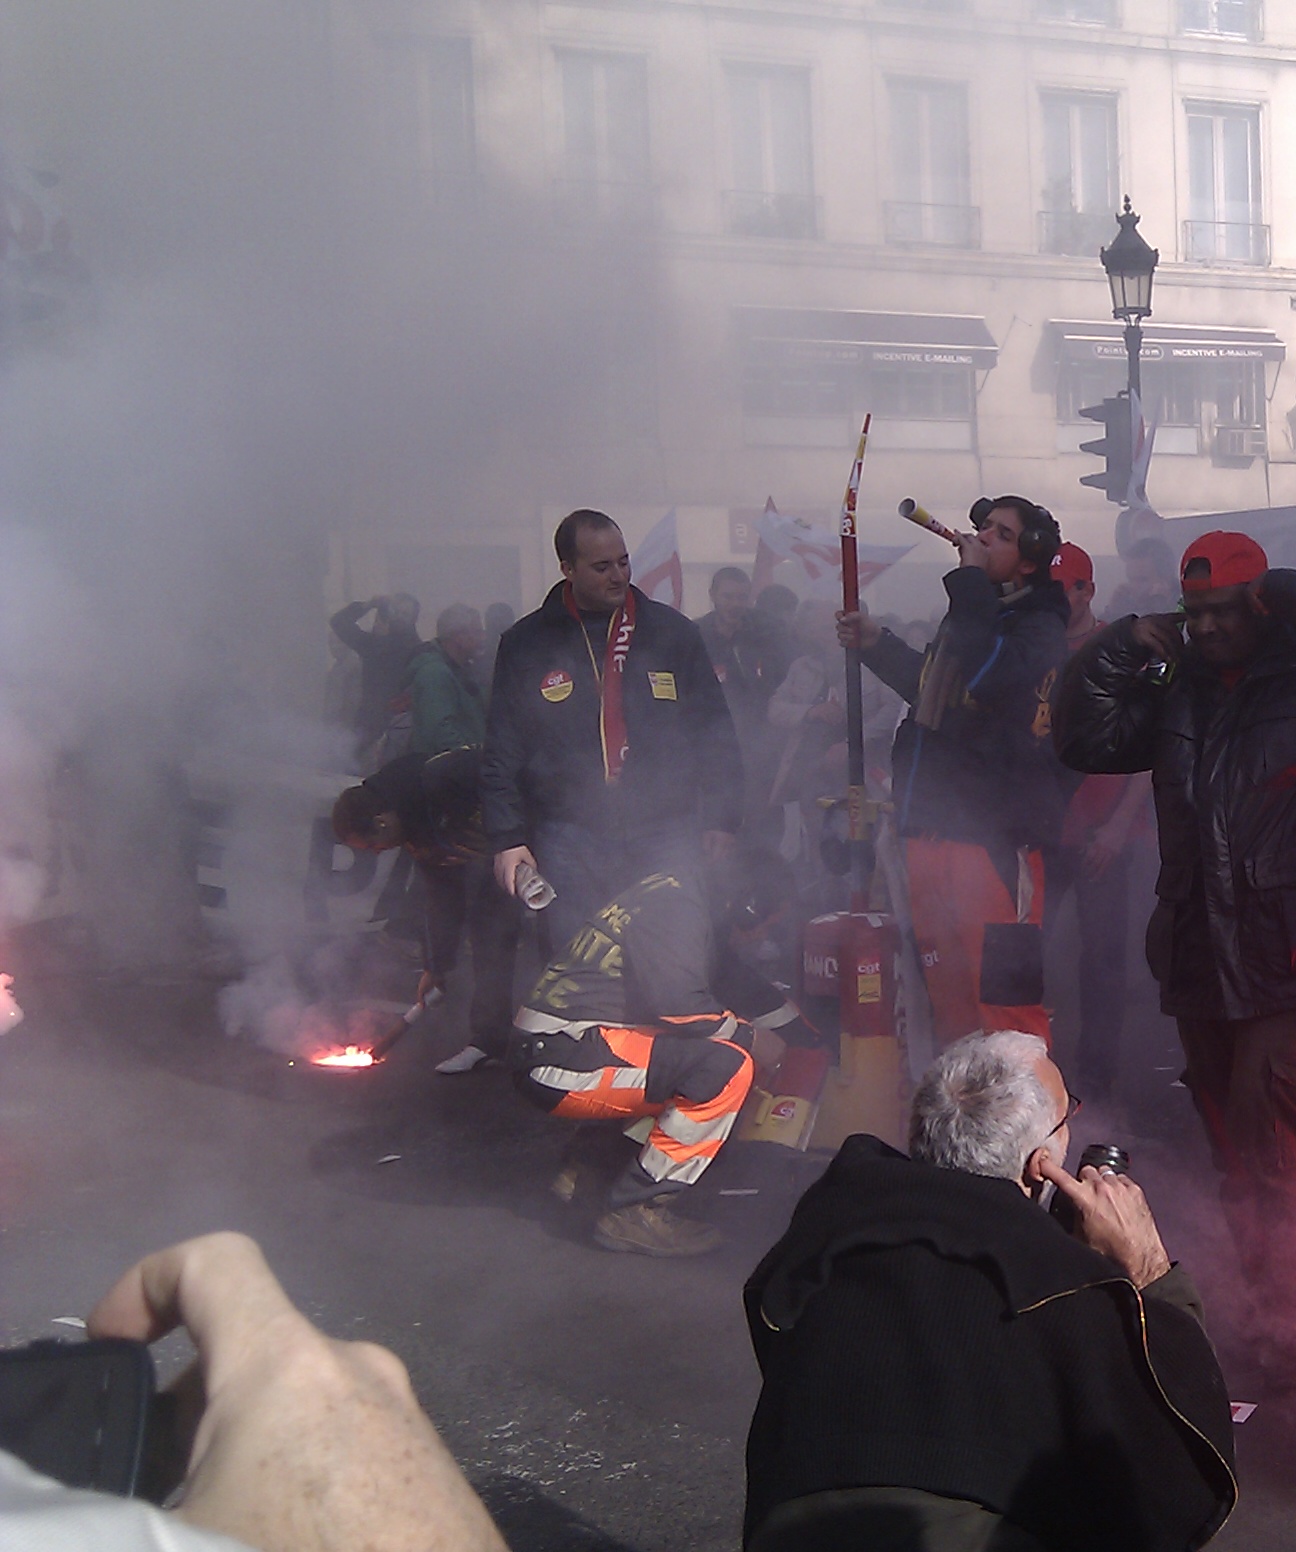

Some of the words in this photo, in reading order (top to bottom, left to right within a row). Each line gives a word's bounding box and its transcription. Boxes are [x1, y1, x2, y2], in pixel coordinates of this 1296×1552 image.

[873, 352, 922, 362] INCENTIVE
[924, 354, 973, 364] E-MAILING
[1172, 349, 1218, 357] INCENTIVE
[547, 674, 564, 687] cgt
[921, 950, 939, 967] gt
[857, 962, 881, 975] cgt
